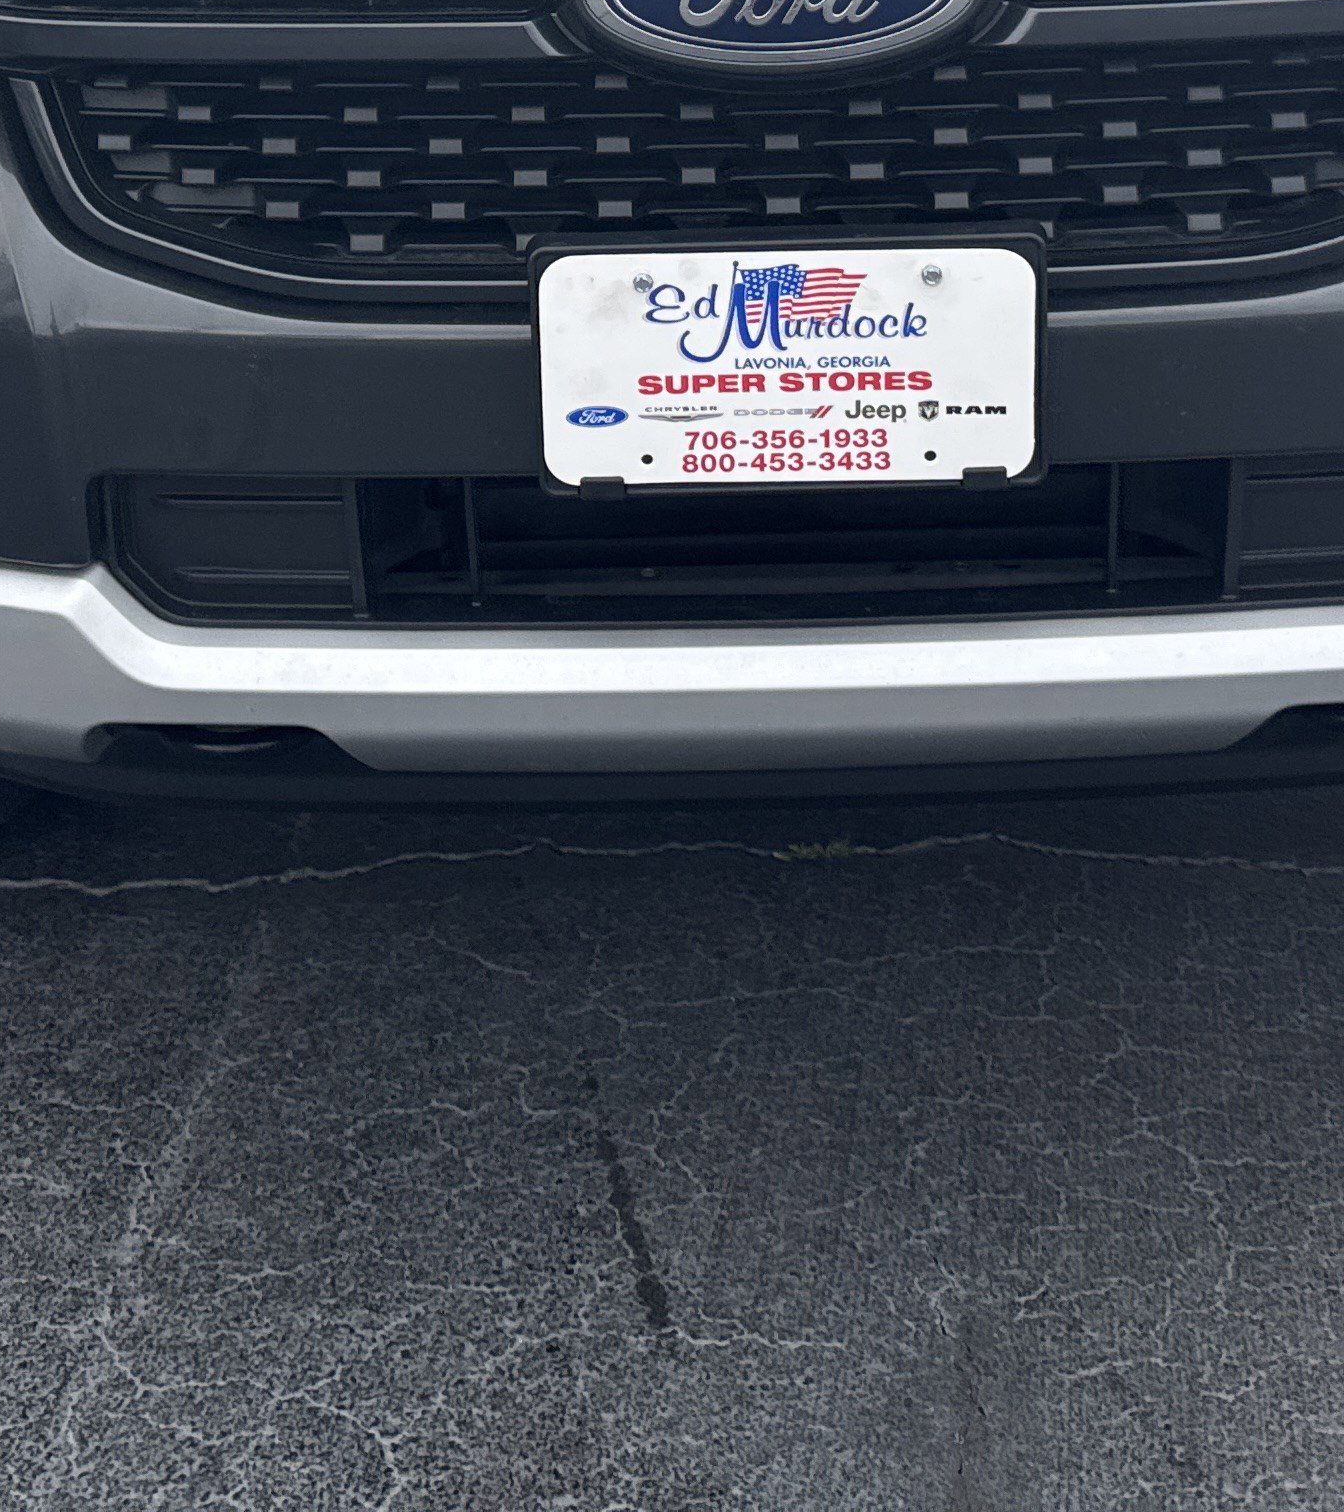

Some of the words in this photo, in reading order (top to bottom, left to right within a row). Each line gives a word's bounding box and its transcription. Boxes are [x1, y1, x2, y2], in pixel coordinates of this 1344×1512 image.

[645, 283, 720, 324] Ed
[678, 278, 928, 364] Murdock
[734, 355, 812, 371] LAVONIA,
[816, 354, 891, 368] GEORGIA
[637, 373, 766, 395] SUPER
[778, 370, 933, 393] STORES
[578, 408, 617, 426] Ford
[644, 405, 718, 413] CHRYSLER
[733, 408, 817, 417] DODGE
[845, 400, 907, 423] Jeep
[946, 404, 1007, 415] RAM
[684, 428, 889, 450] 706-356-1933
[681, 451, 892, 473] 800-453-3433
